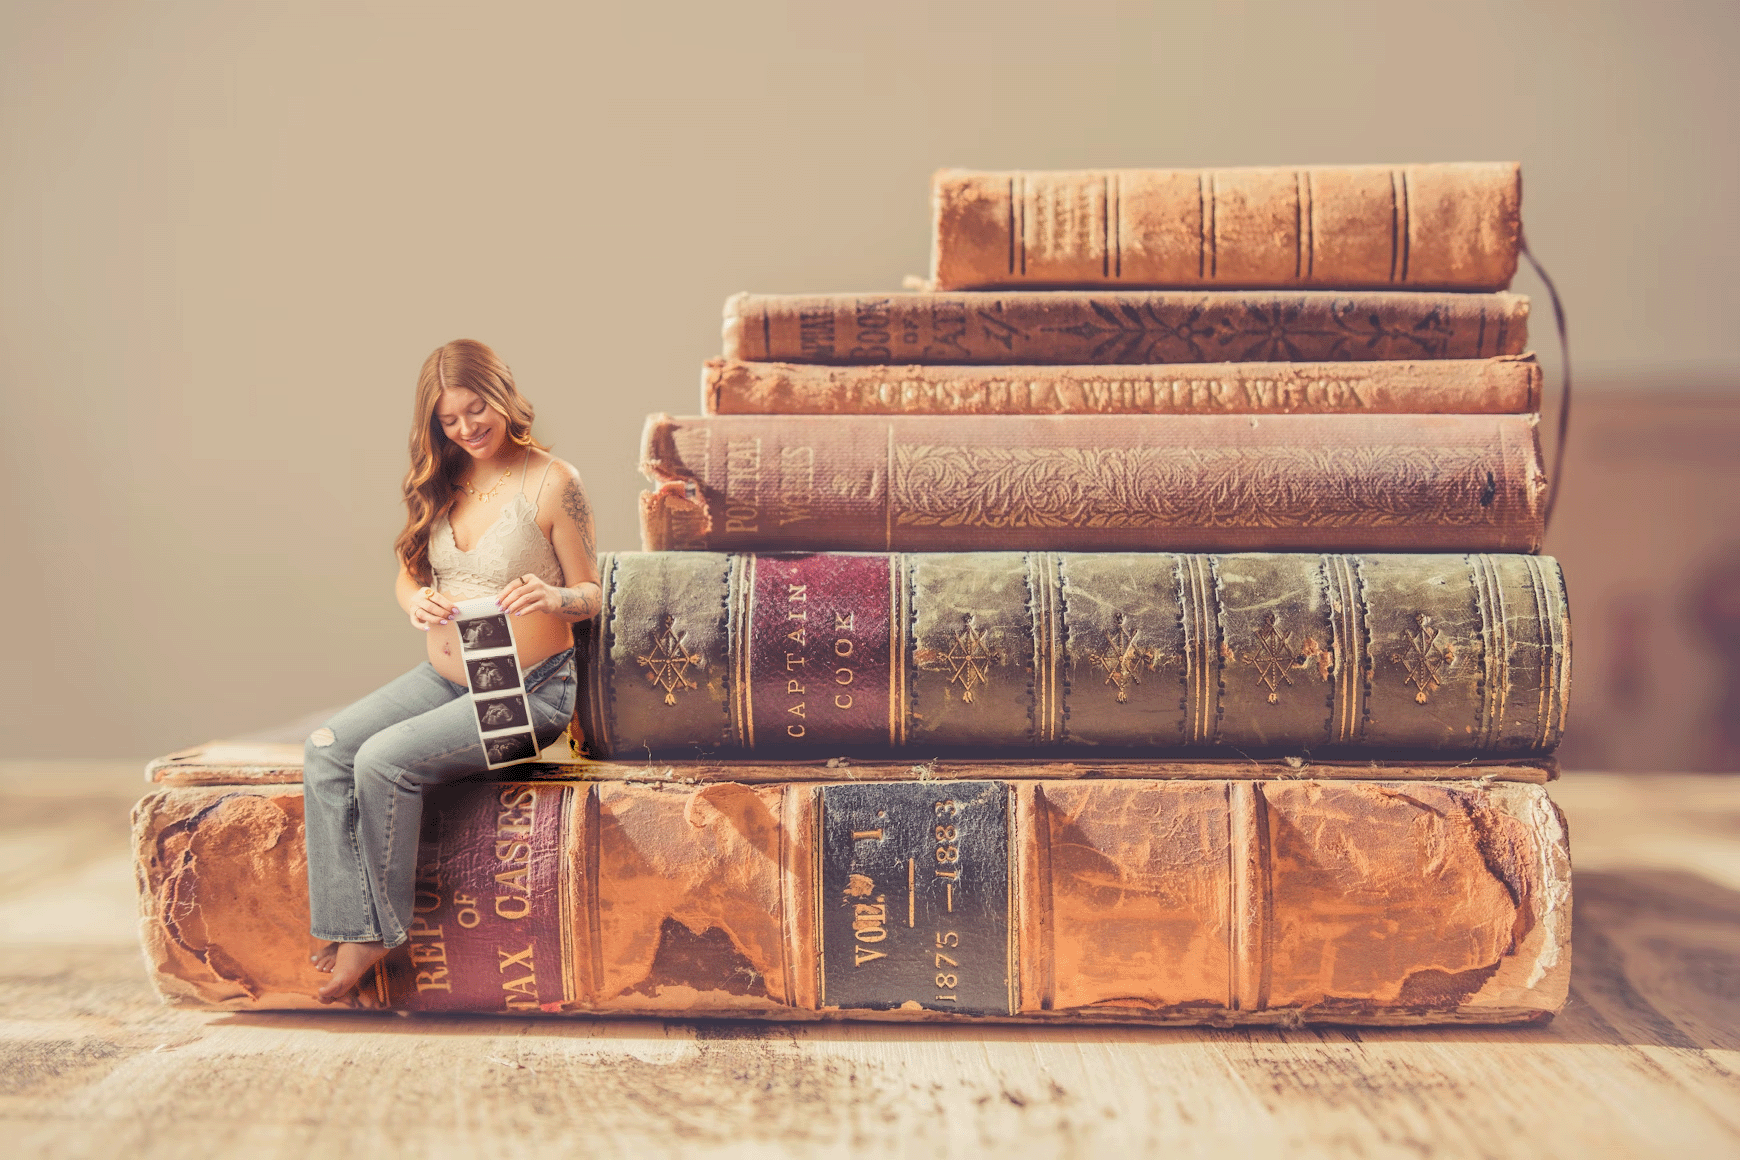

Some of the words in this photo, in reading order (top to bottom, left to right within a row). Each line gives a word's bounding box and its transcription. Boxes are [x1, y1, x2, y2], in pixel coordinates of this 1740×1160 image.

[726, 437, 760, 533] POETICAL
[787, 584, 807, 738] CAPTAIN
[835, 612, 855, 709] COOK
[495, 789, 537, 920] CASES
[455, 890, 481, 929] OF
[499, 943, 540, 1012] TAX
